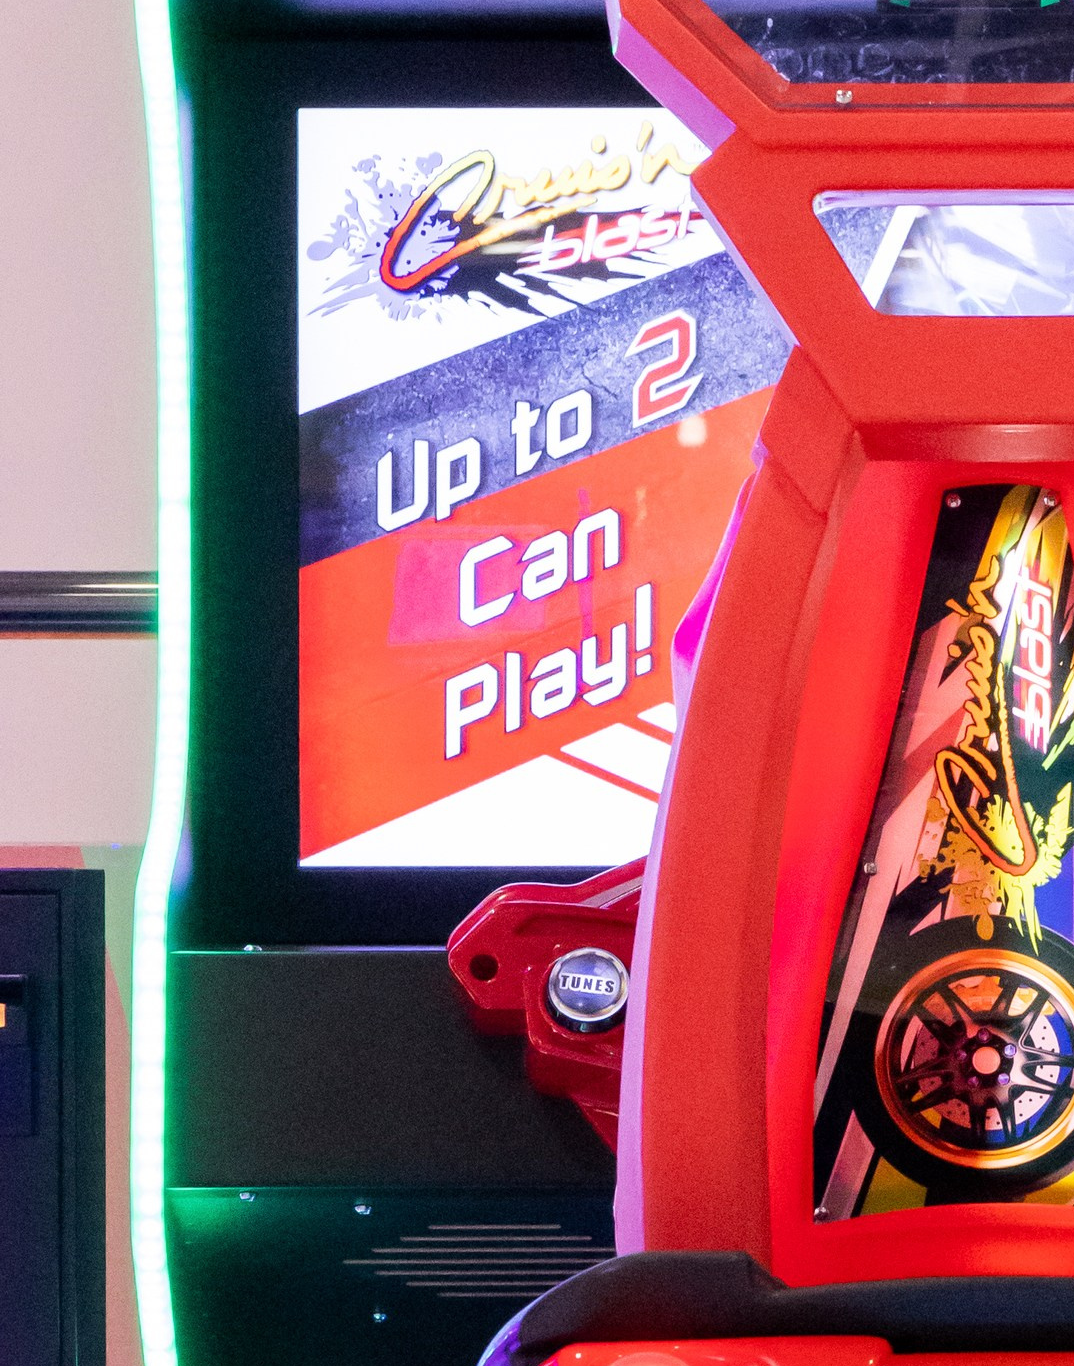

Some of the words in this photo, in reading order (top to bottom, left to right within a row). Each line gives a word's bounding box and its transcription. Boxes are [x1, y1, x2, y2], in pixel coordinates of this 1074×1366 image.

[380, 120, 701, 291] Cruis'n
[535, 193, 697, 272] blast
[375, 439, 482, 534] Up
[511, 389, 593, 476] to
[624, 309, 705, 430] 2
[457, 507, 622, 628] Can
[1012, 565, 1055, 744] blast
[443, 583, 654, 762] Play!
[935, 555, 1038, 876] Cruis'n
[561, 975, 615, 993] TUNES
